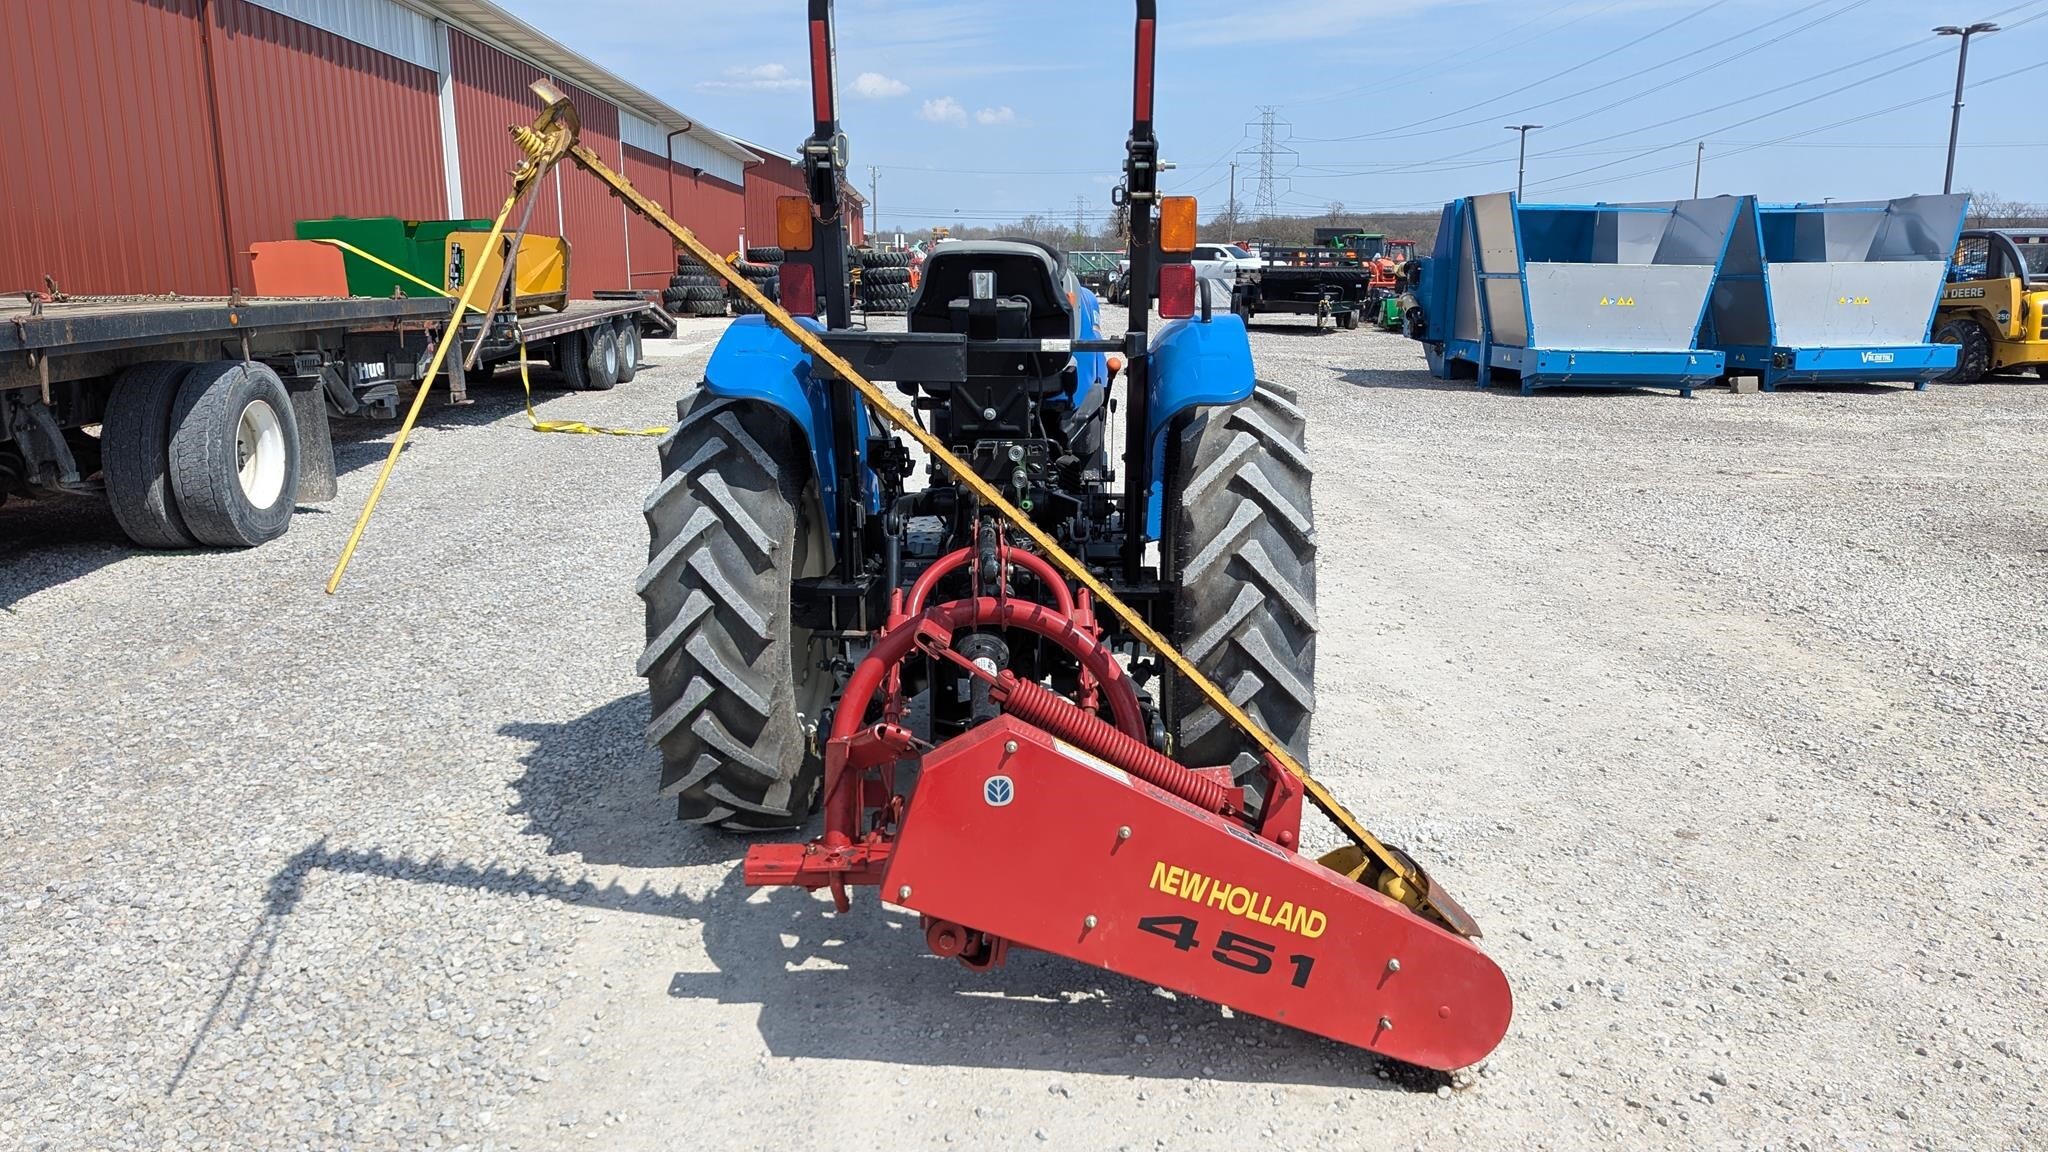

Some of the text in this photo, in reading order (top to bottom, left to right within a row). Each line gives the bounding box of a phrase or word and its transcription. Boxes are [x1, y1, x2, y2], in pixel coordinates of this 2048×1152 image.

[1951, 287, 1984, 298] DEERE
[1149, 861, 1328, 939] NEW HOLLAND
[1137, 915, 1315, 989] 451
